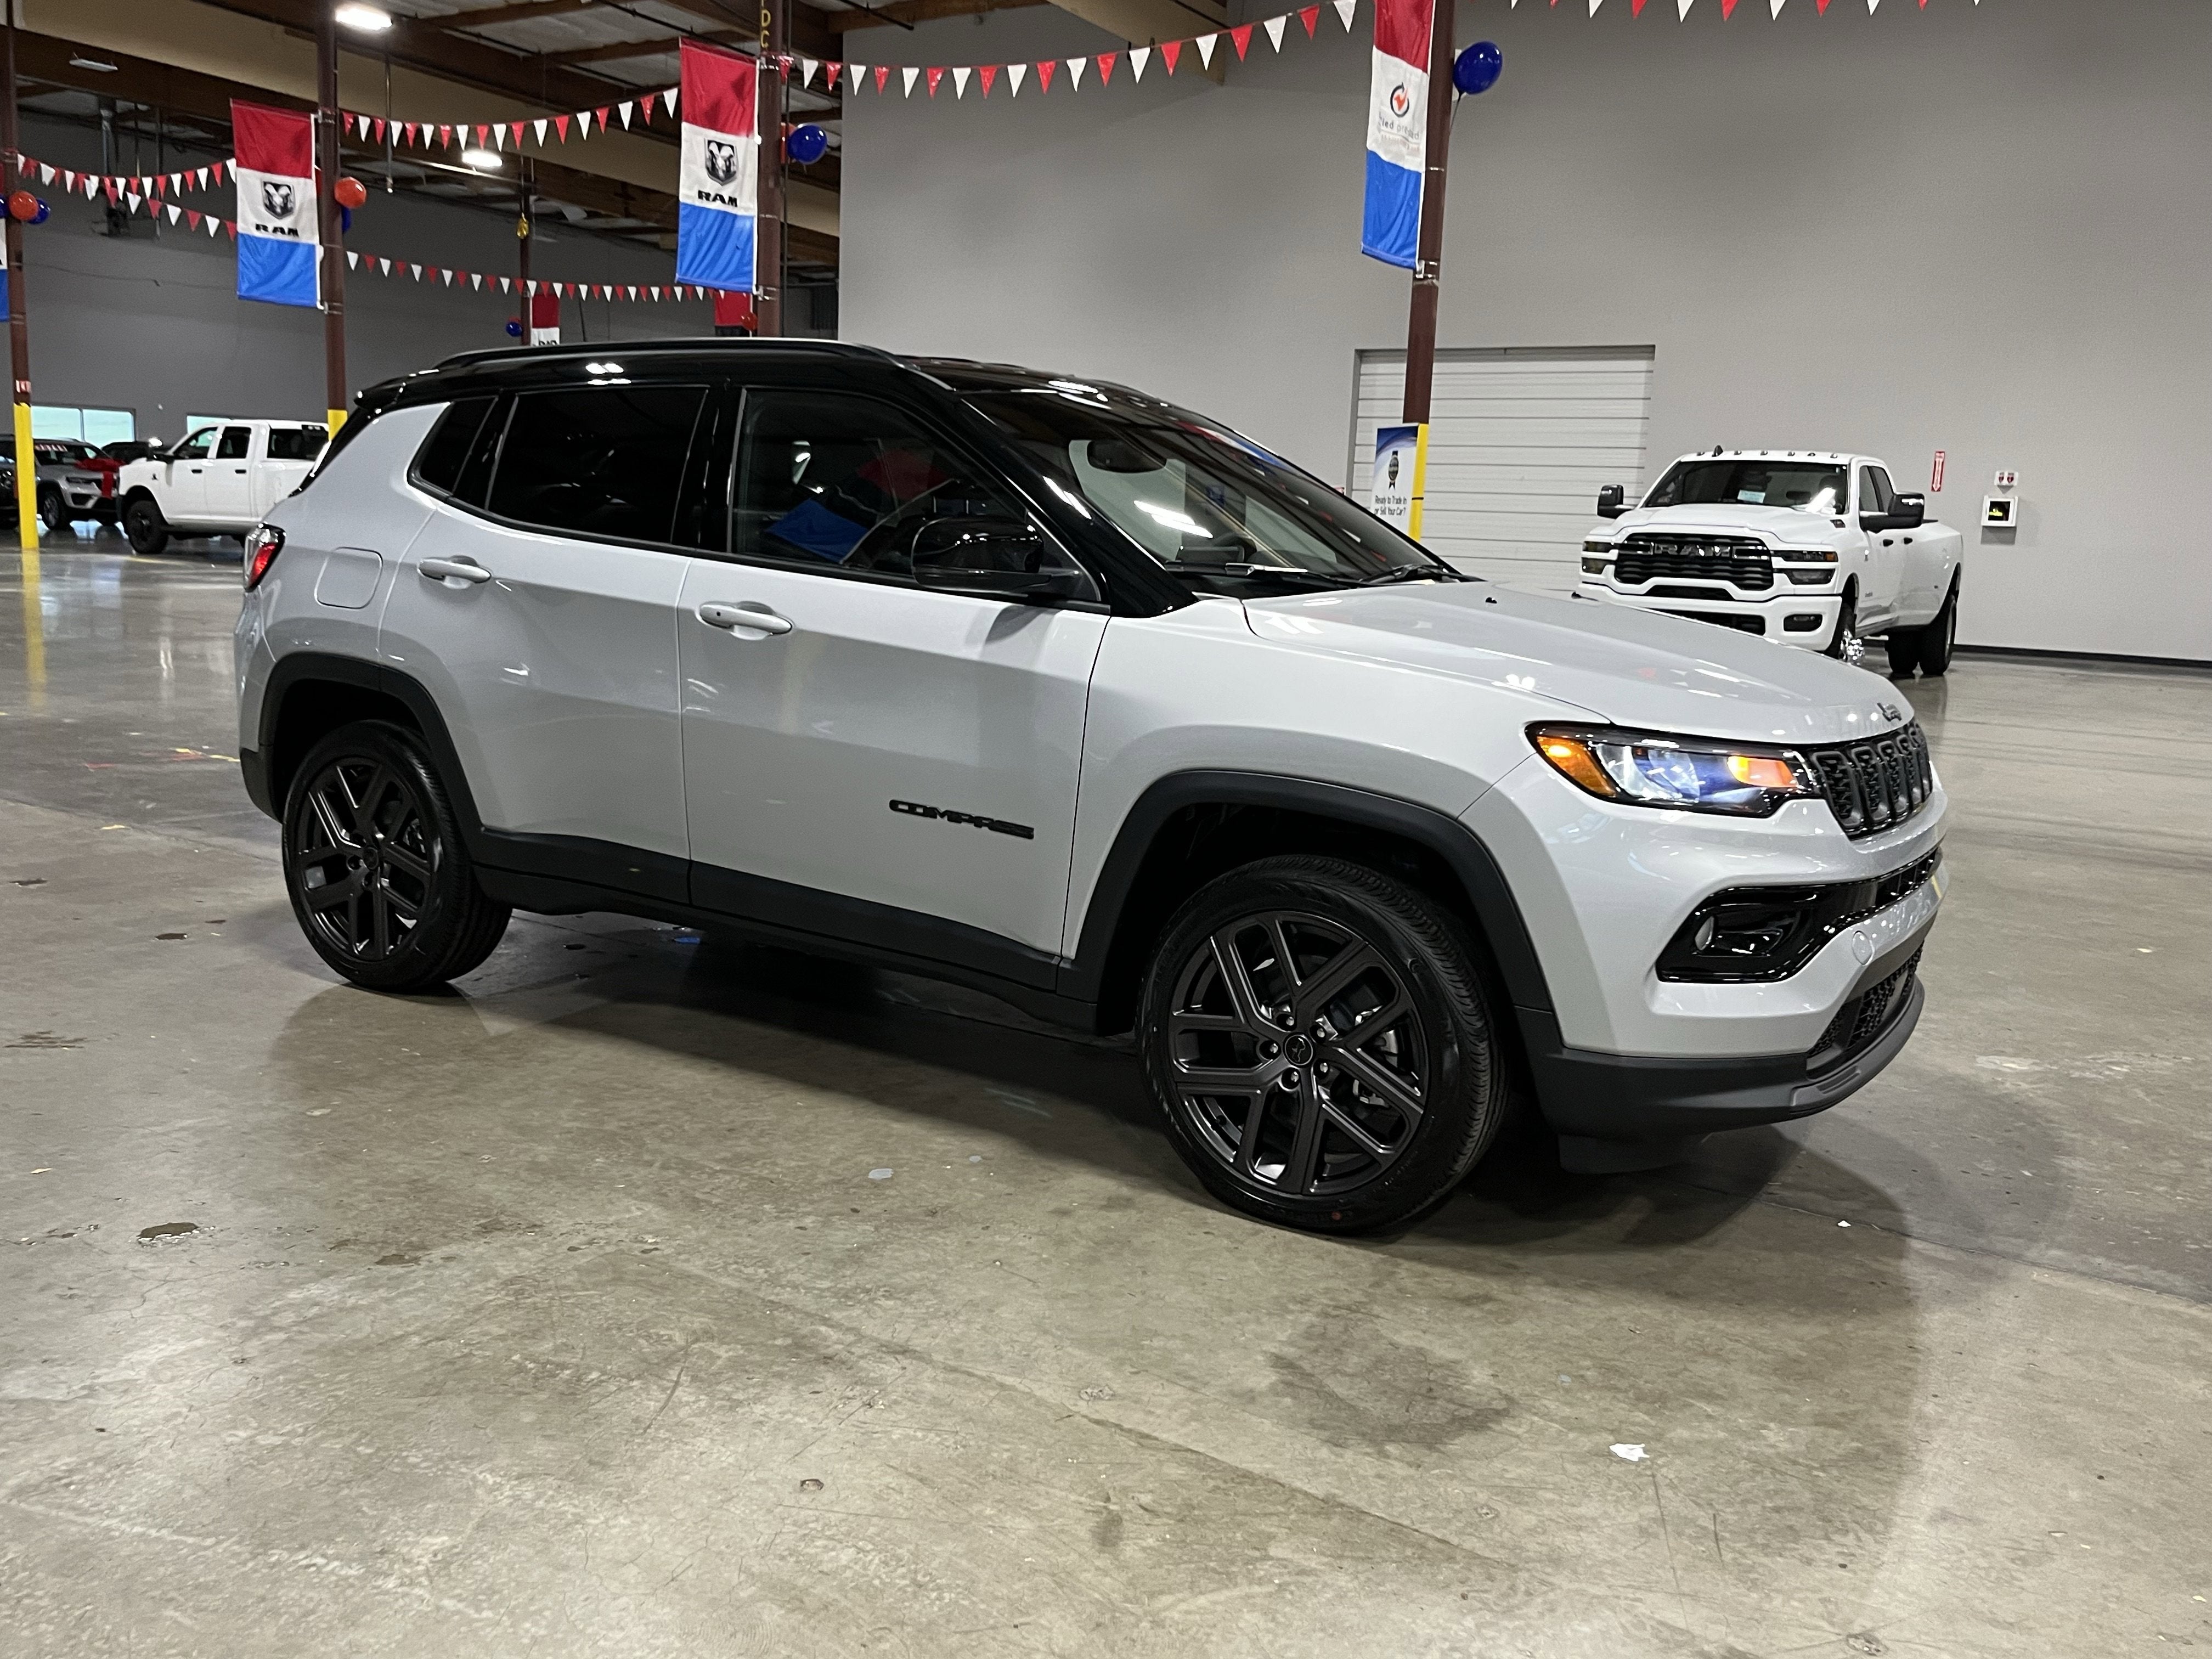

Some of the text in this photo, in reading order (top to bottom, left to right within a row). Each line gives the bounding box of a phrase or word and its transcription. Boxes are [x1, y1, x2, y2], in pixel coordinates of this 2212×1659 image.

[697, 190, 738, 207] RAM
[255, 223, 300, 238] RAM
[1392, 495, 1402, 505] Trade
[1387, 506, 1396, 516] Your
[1654, 543, 1730, 557] RAM
